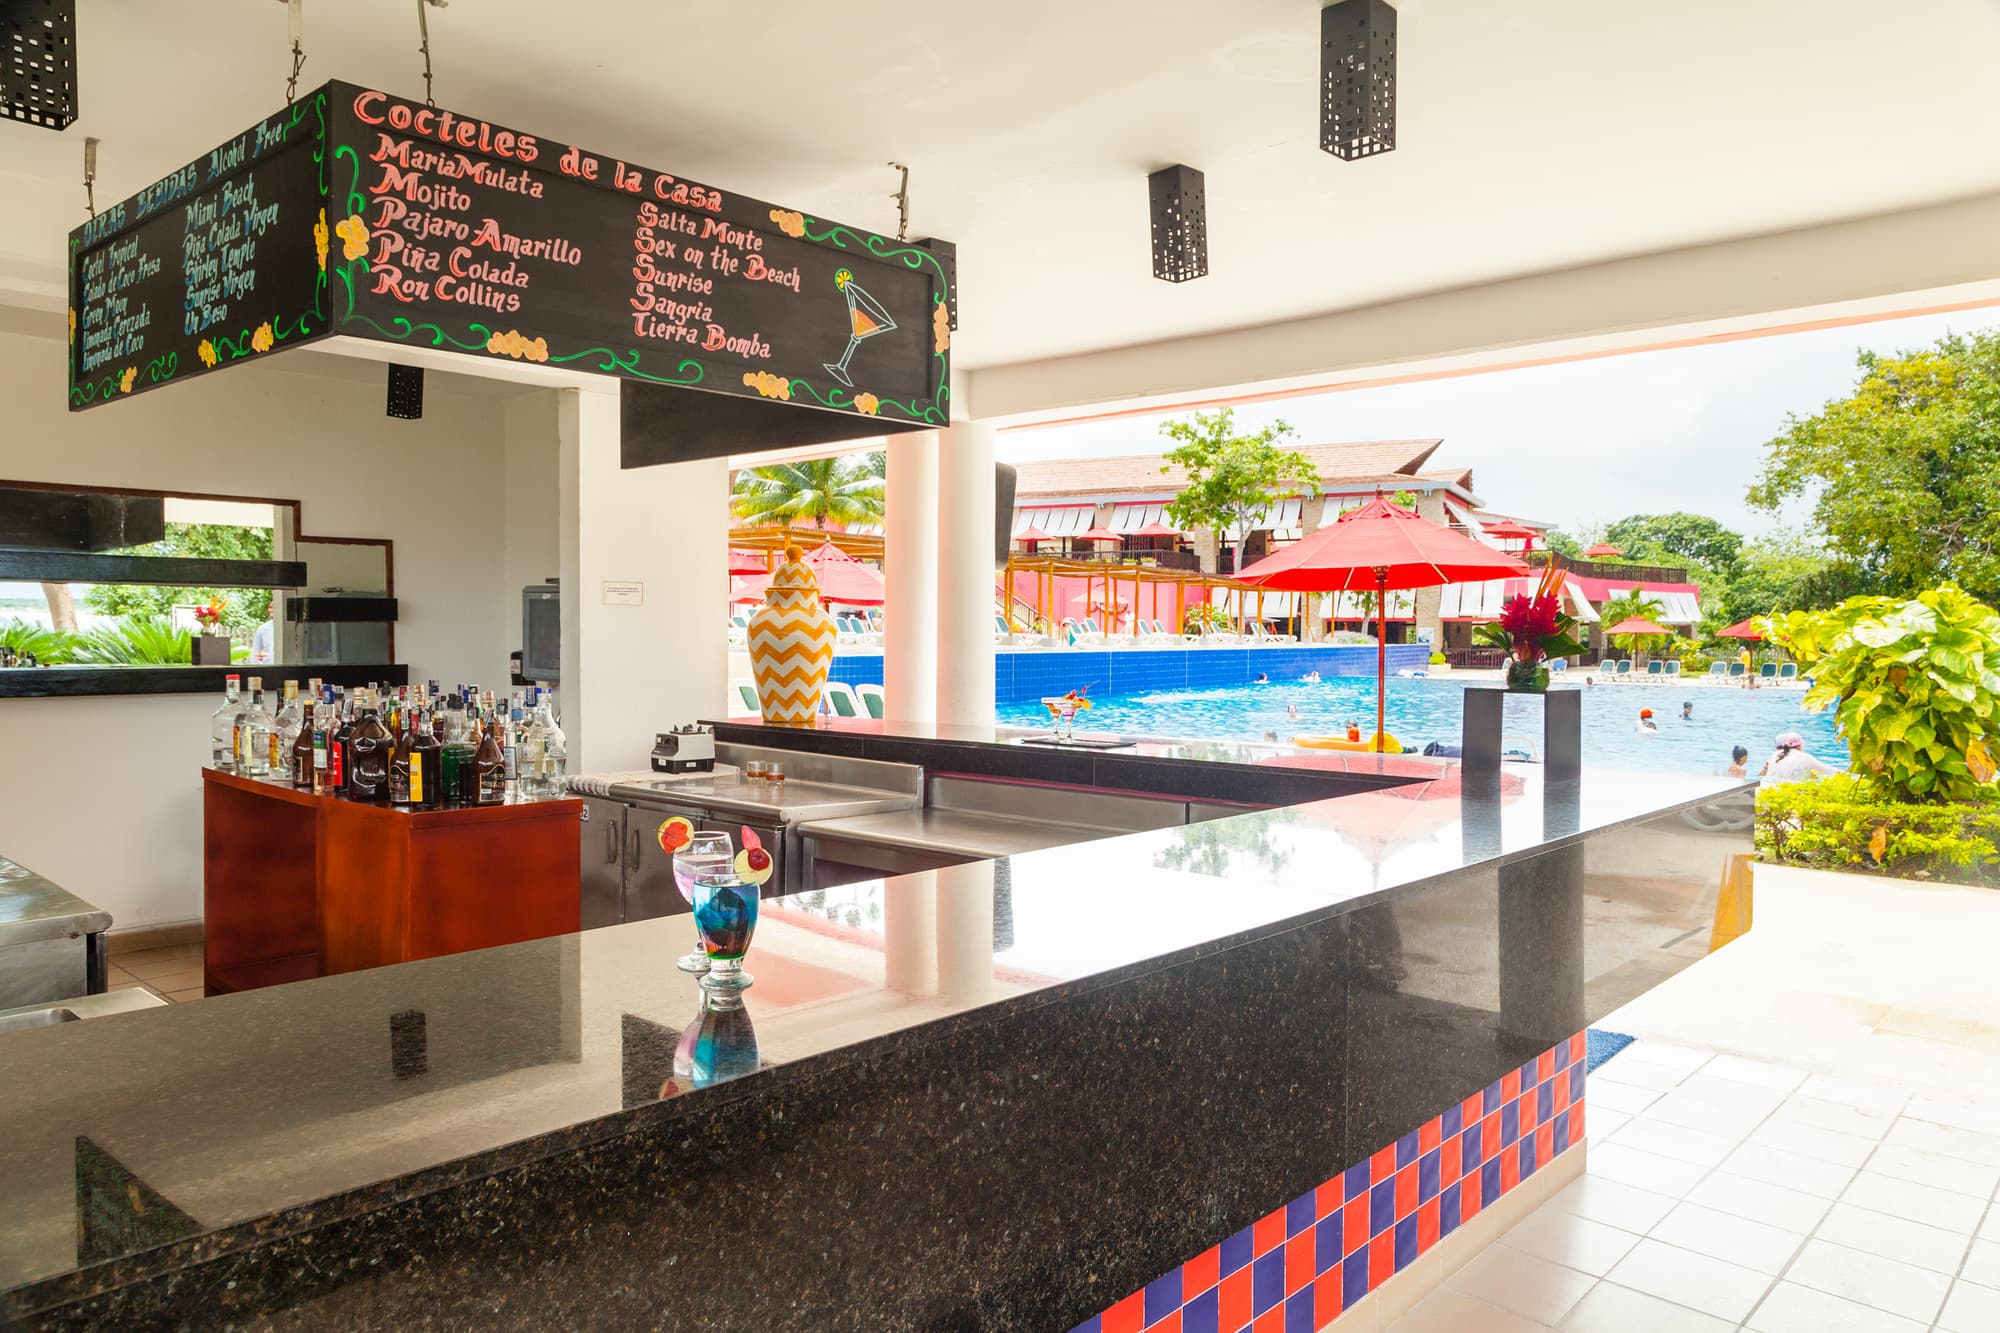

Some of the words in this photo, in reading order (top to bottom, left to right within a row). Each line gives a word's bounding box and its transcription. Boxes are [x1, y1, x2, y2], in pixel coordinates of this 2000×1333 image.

[353, 91, 538, 161] Cocteles
[559, 146, 599, 180] de
[615, 161, 643, 192] la
[654, 174, 722, 212] Casa
[84, 203, 126, 248] OTRAS
[136, 163, 198, 219] BEBIDAS
[207, 136, 246, 182] Alcohol
[252, 119, 282, 158] Free
[184, 194, 217, 234] Miami
[222, 173, 255, 217] Beach
[369, 163, 471, 211] Mojito
[208, 212, 240, 251] Colada
[244, 198, 279, 237] Virgen
[371, 196, 469, 241] Pajaro
[471, 218, 582, 266] Amarillo
[637, 201, 697, 236] Salta
[700, 218, 763, 251] Monte
[185, 253, 219, 288] Shirley
[220, 236, 255, 273] Temple
[223, 268, 255, 300] Virgen
[371, 230, 440, 273] Piña
[449, 246, 529, 289] Colada
[632, 253, 713, 295] Sunrise
[634, 226, 677, 259] Sex
[684, 245, 704, 270] on
[710, 244, 739, 274] the
[743, 254, 800, 293] Beach
[370, 264, 430, 303] Ron
[434, 275, 520, 313] Collins
[630, 282, 713, 326] Sangria
[184, 311, 200, 335] Un
[200, 303, 227, 331] Beso
[632, 311, 698, 344] Tierra
[701, 323, 771, 359] Bomba
[114, 337, 124, 358] de
